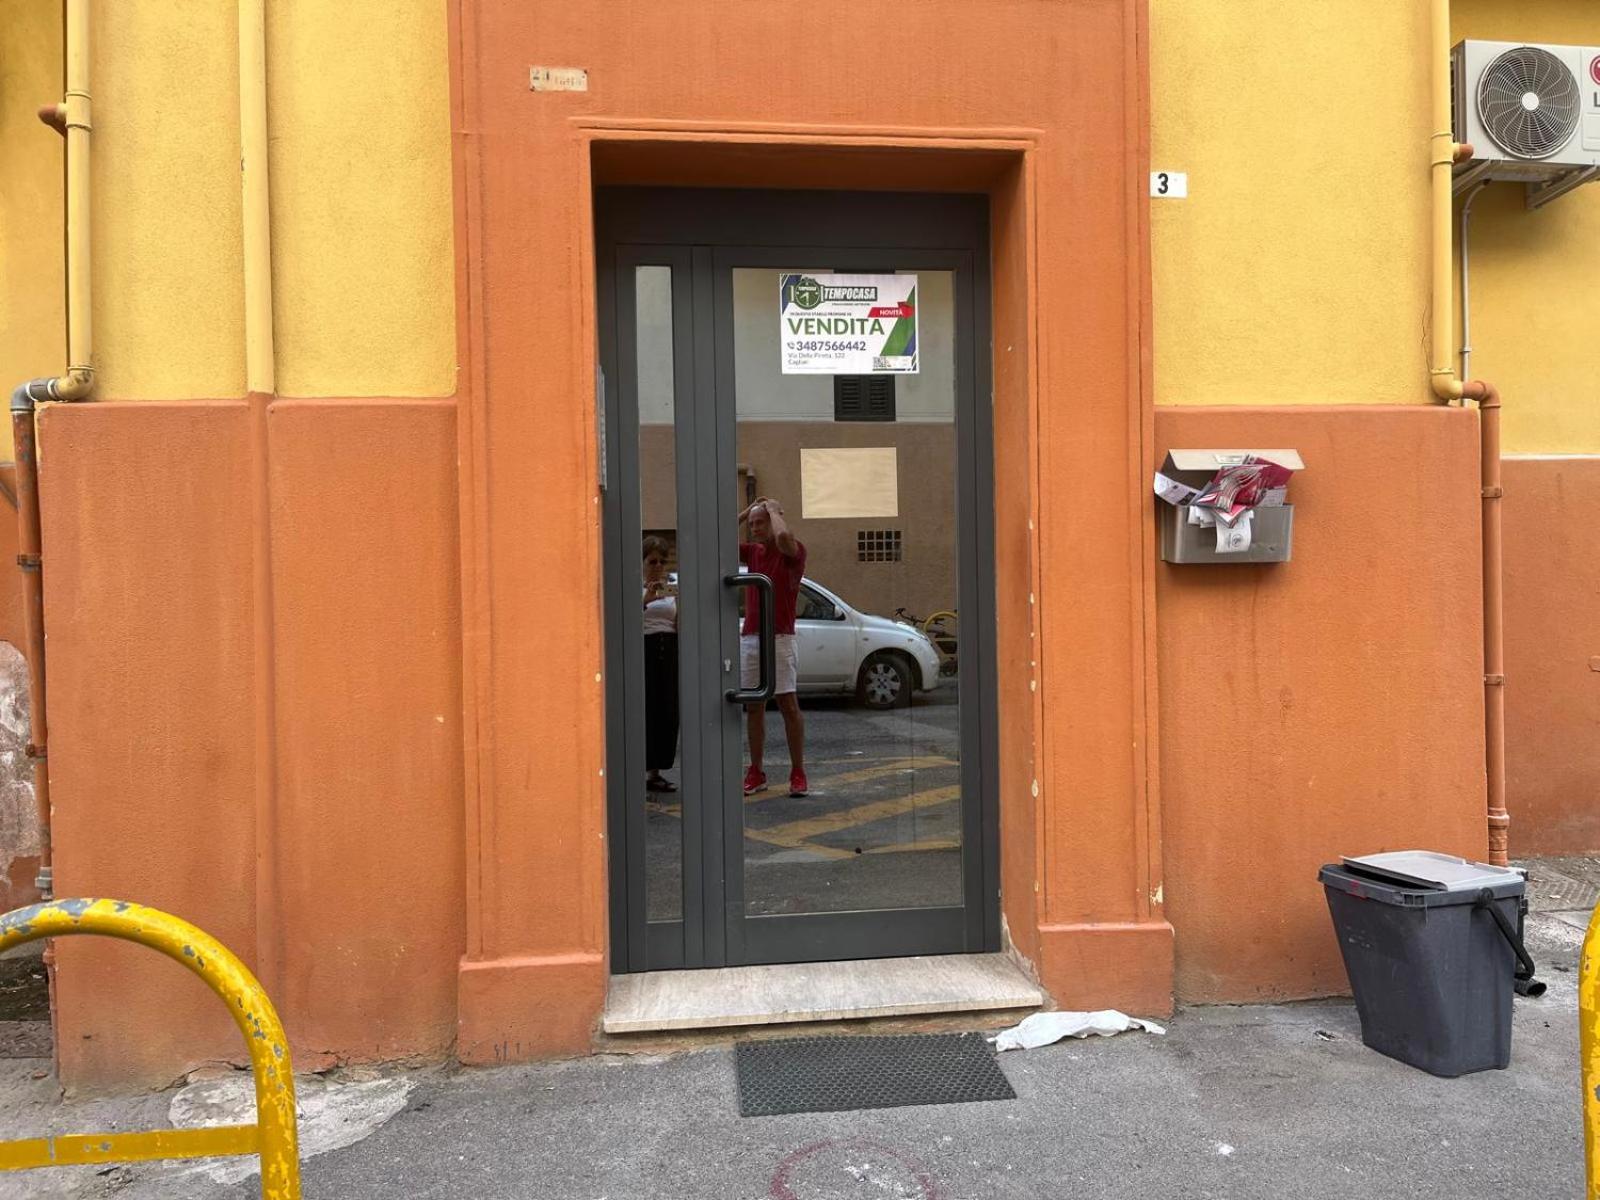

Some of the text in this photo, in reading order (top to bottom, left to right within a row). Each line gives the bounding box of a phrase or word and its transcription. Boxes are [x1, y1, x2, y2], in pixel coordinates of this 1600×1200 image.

[1157, 172, 1169, 195] 3
[824, 287, 876, 301] TEMPOCASA
[879, 308, 903, 316] NOVITÀ
[787, 318, 885, 336] VENDITA
[796, 341, 867, 352] 3487566442
